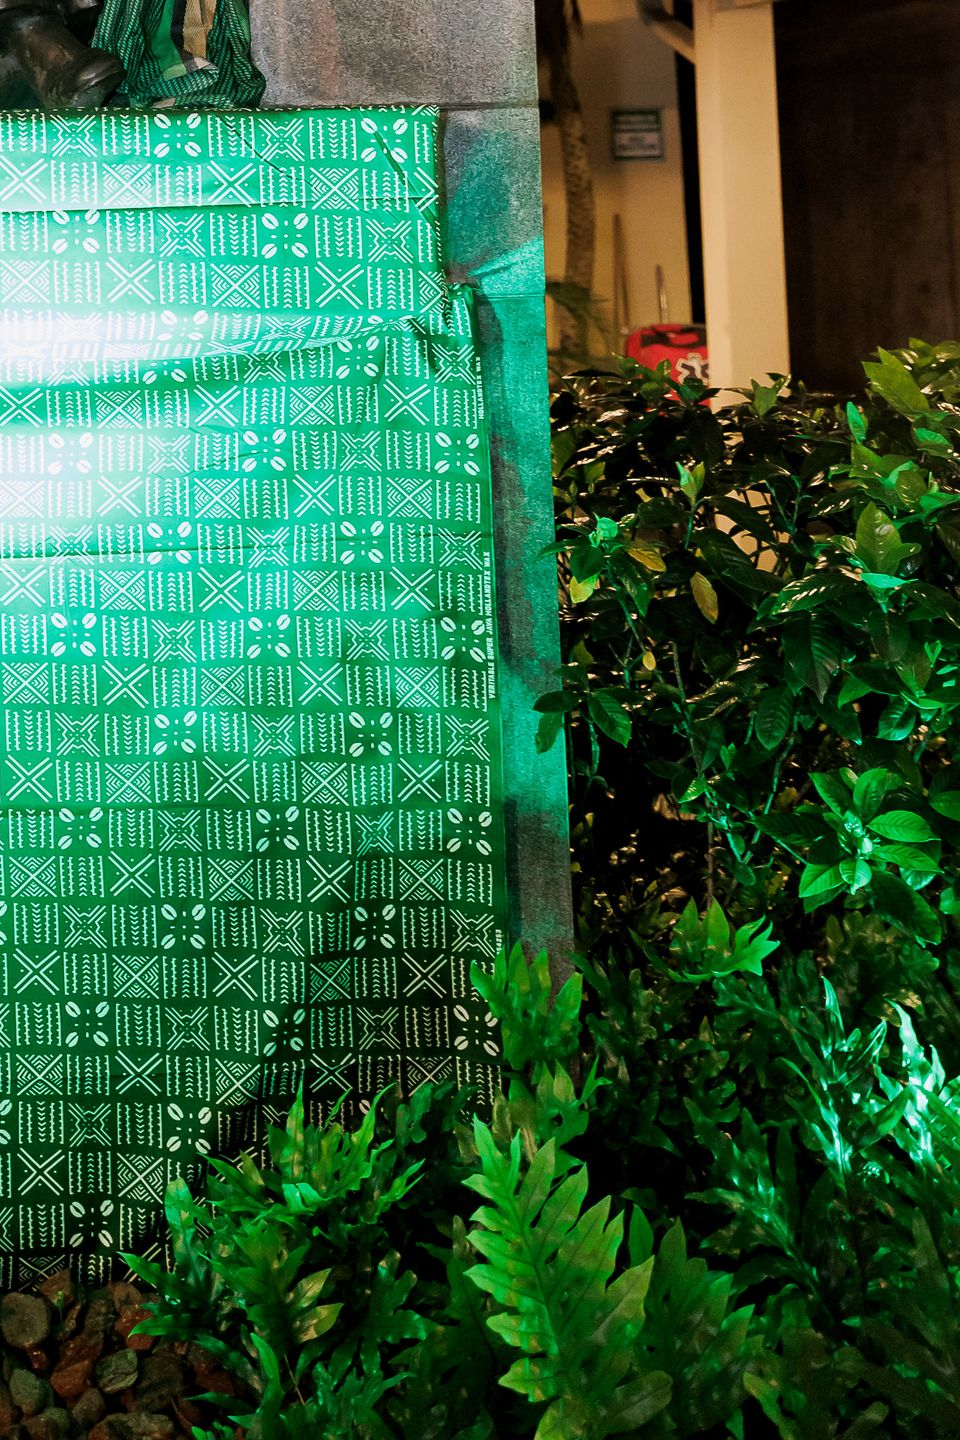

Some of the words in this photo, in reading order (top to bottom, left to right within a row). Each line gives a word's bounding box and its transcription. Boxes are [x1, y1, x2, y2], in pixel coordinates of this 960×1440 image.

[476, 375, 485, 420] HOLLANDTEX
[483, 551, 491, 567] WAX
[484, 570, 492, 616] HOLLANDTEX
[485, 617, 493, 635] JAVA
[486, 637, 495, 660] SUPER
[487, 662, 496, 699] VERITABLE
